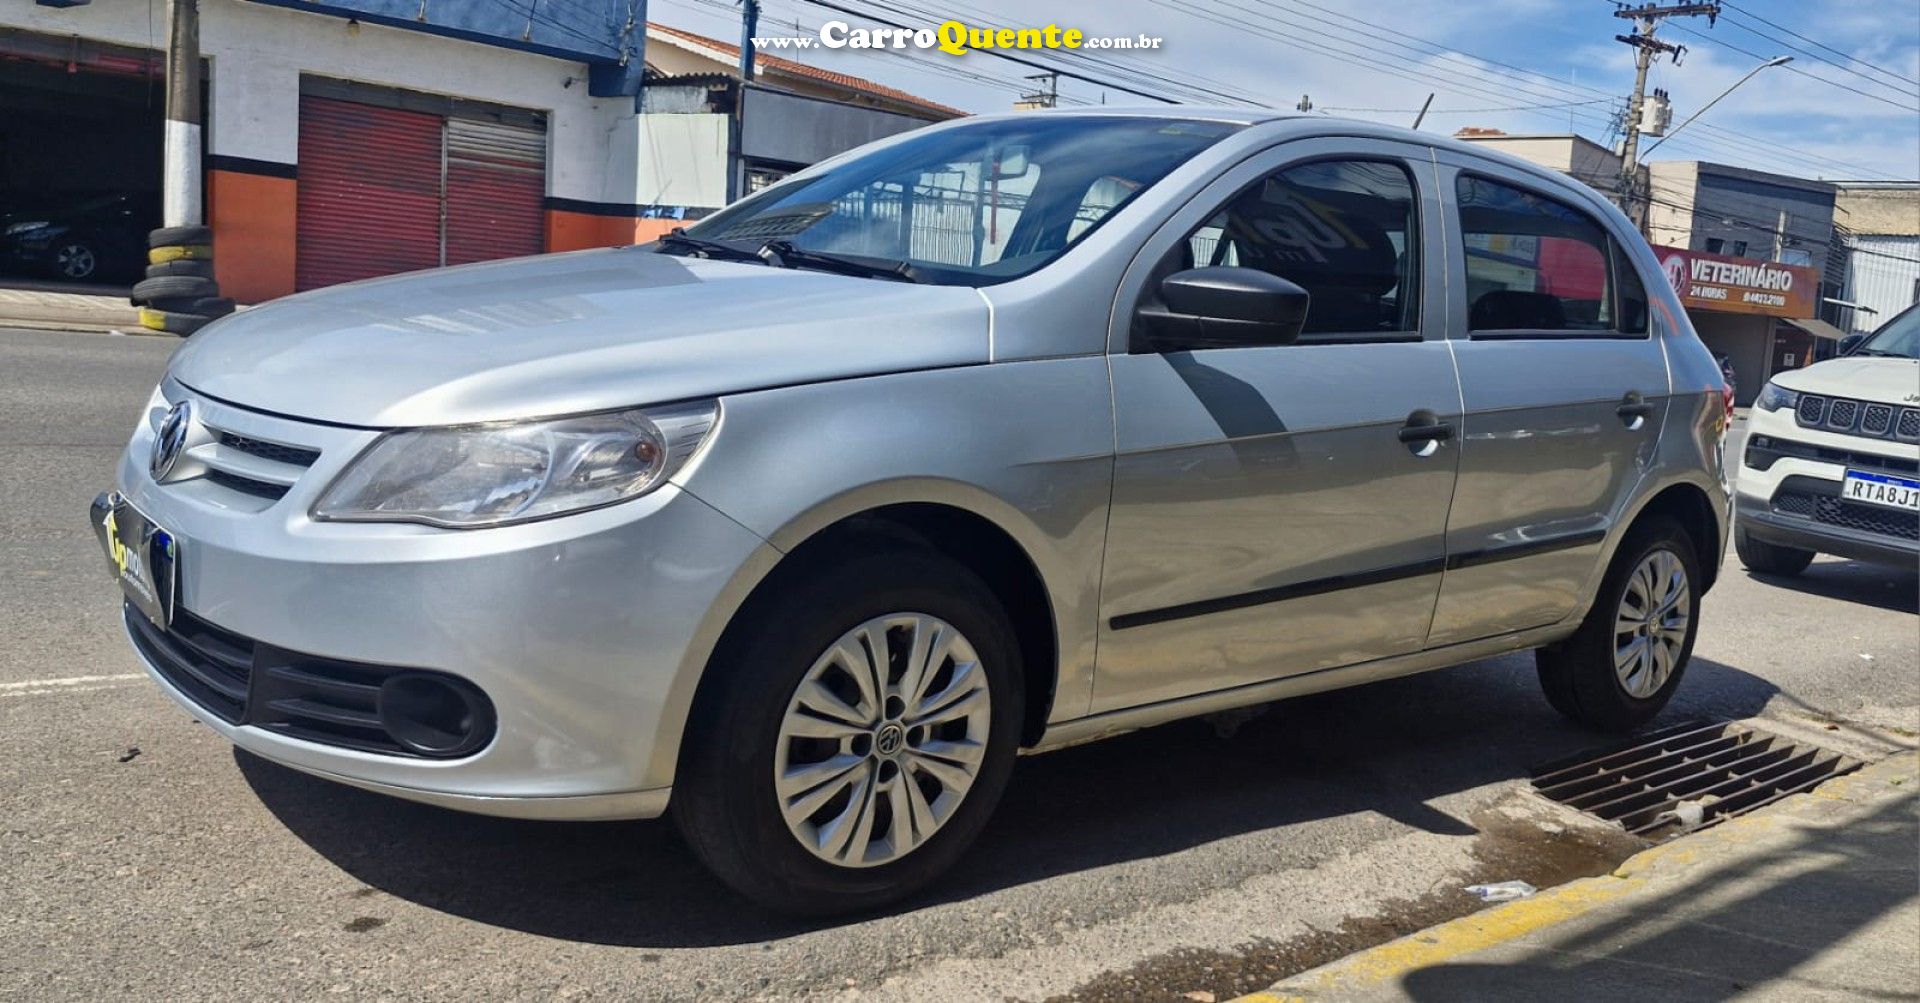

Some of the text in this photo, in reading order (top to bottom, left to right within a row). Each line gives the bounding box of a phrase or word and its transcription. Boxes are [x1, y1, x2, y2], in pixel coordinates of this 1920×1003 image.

[1690, 258, 1792, 291] VETERINÁRIO
[1690, 286, 1700, 297] 24
[1701, 287, 1728, 300] HORAS
[1852, 481, 1920, 506] RTA8J1
